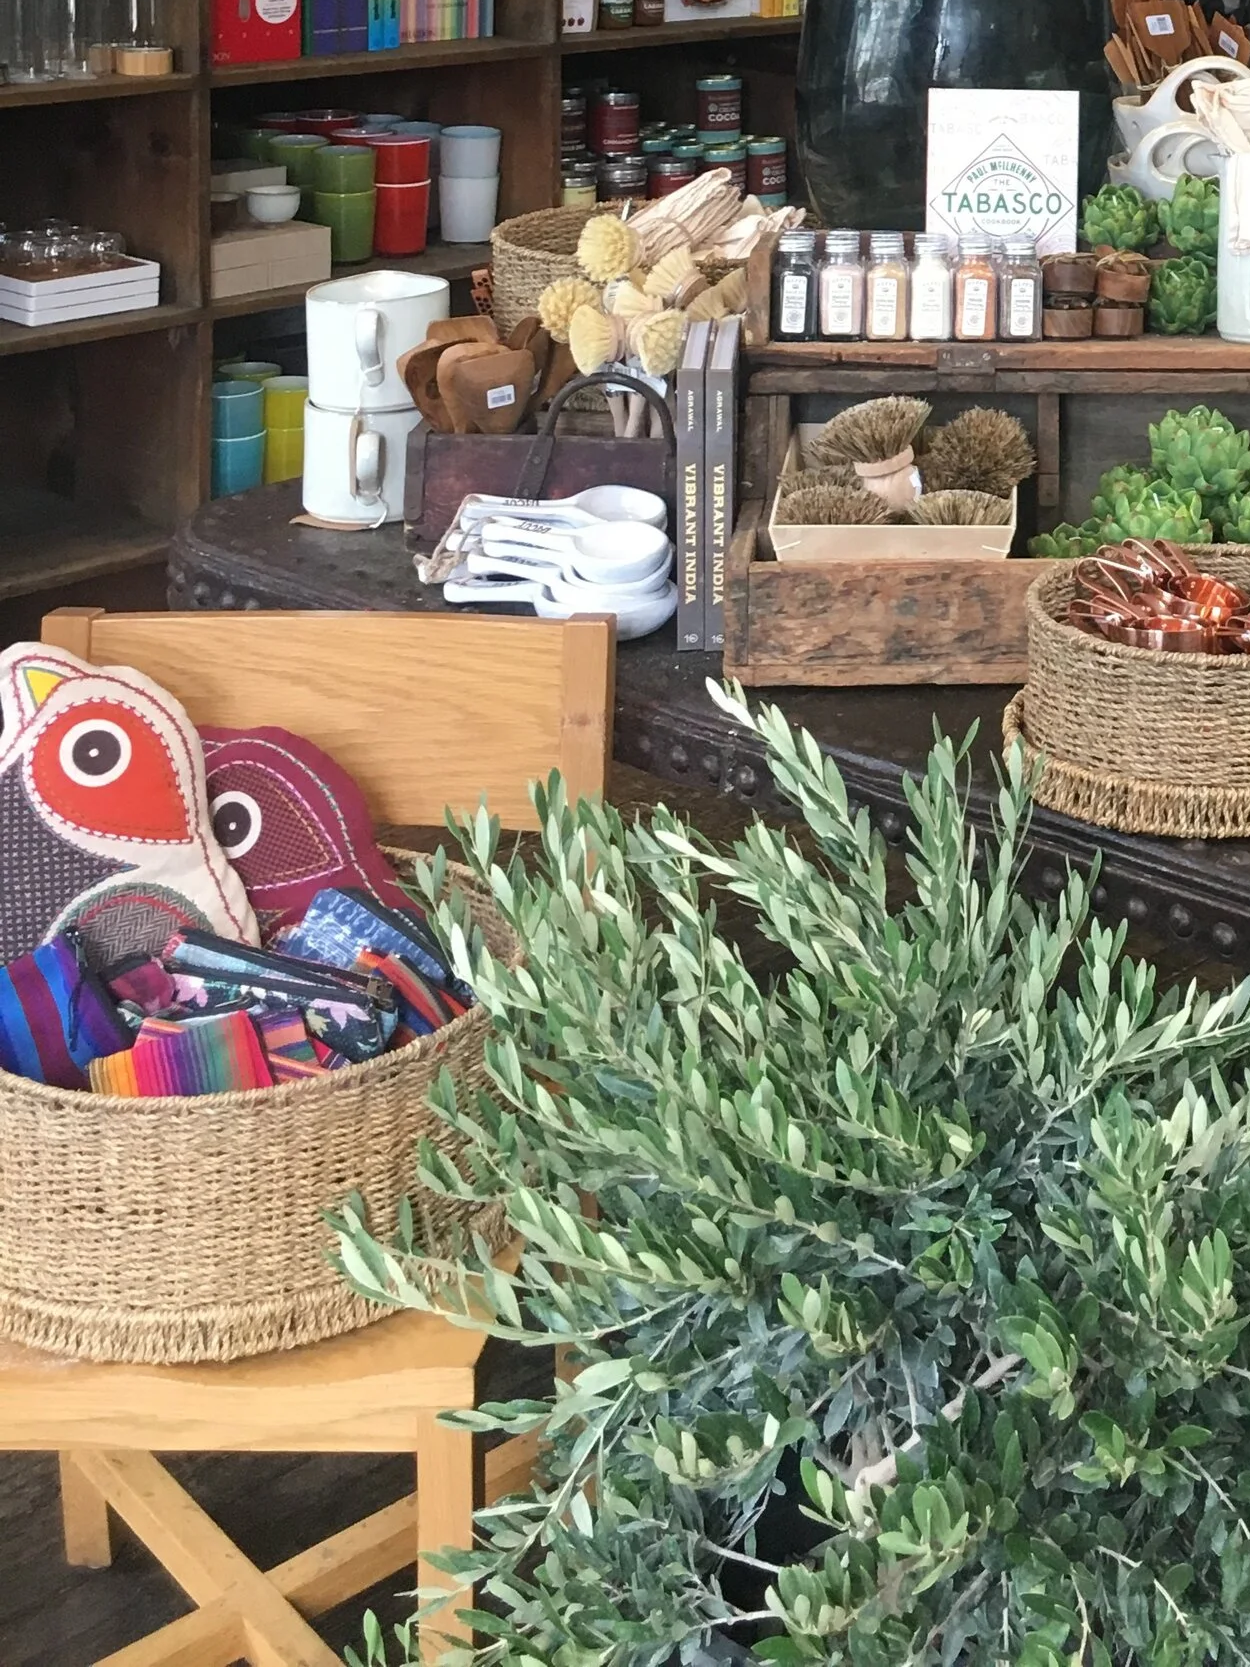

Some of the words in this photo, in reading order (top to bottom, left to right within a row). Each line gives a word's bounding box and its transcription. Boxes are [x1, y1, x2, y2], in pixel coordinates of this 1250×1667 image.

[966, 166, 988, 184] PAUL
[942, 193, 1062, 214] TABASCO
[685, 463, 697, 546] VIBRANT
[713, 464, 725, 546] VIBRANT
[685, 552, 697, 605] INDIA
[712, 552, 725, 605] INDIA
